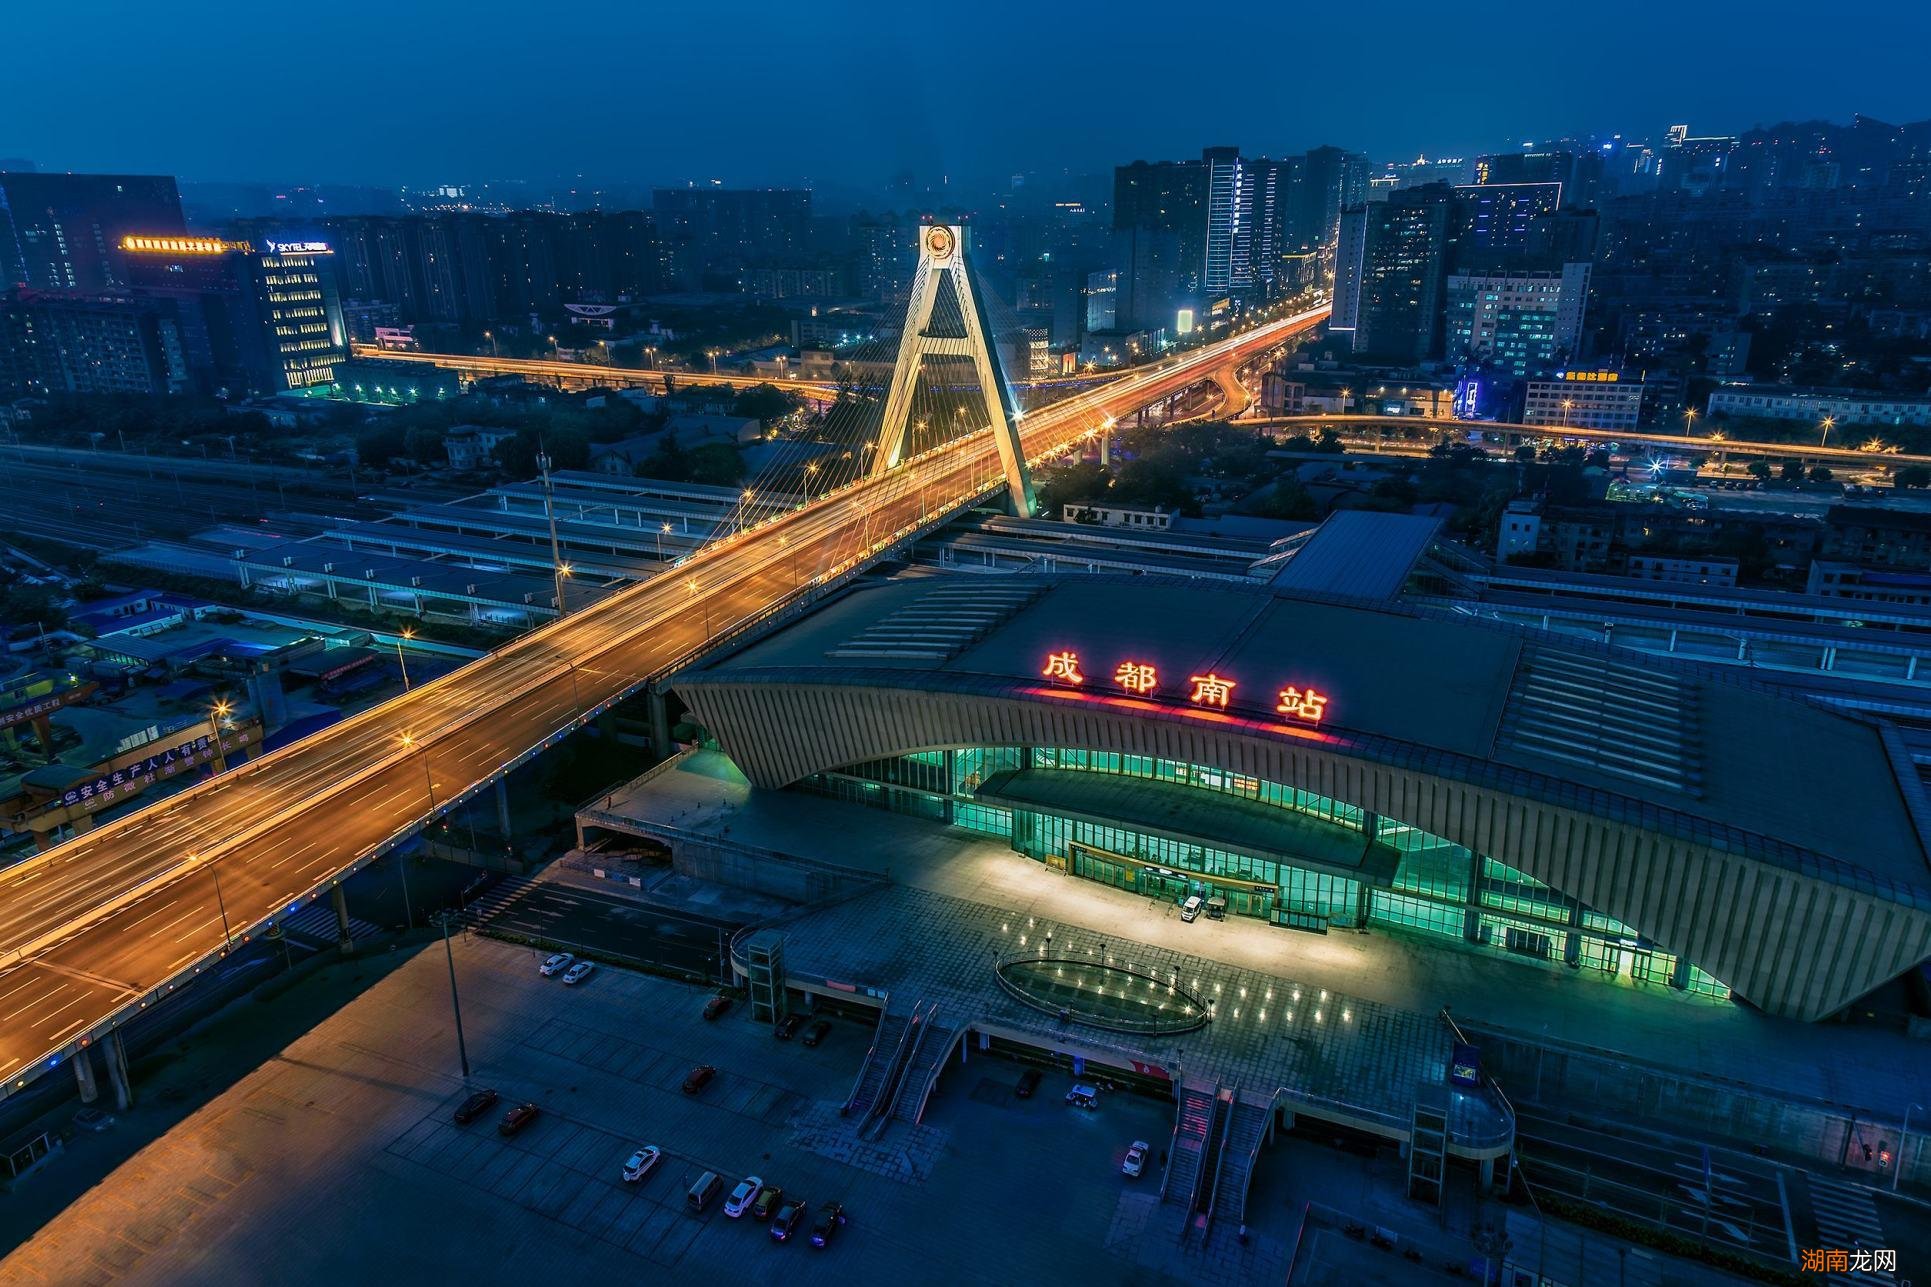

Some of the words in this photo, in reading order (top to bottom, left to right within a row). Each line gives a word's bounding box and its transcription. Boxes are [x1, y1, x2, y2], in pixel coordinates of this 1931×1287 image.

[1042, 651, 1328, 720] 成都南站
[80, 736, 209, 799] 安全生产人人有责
